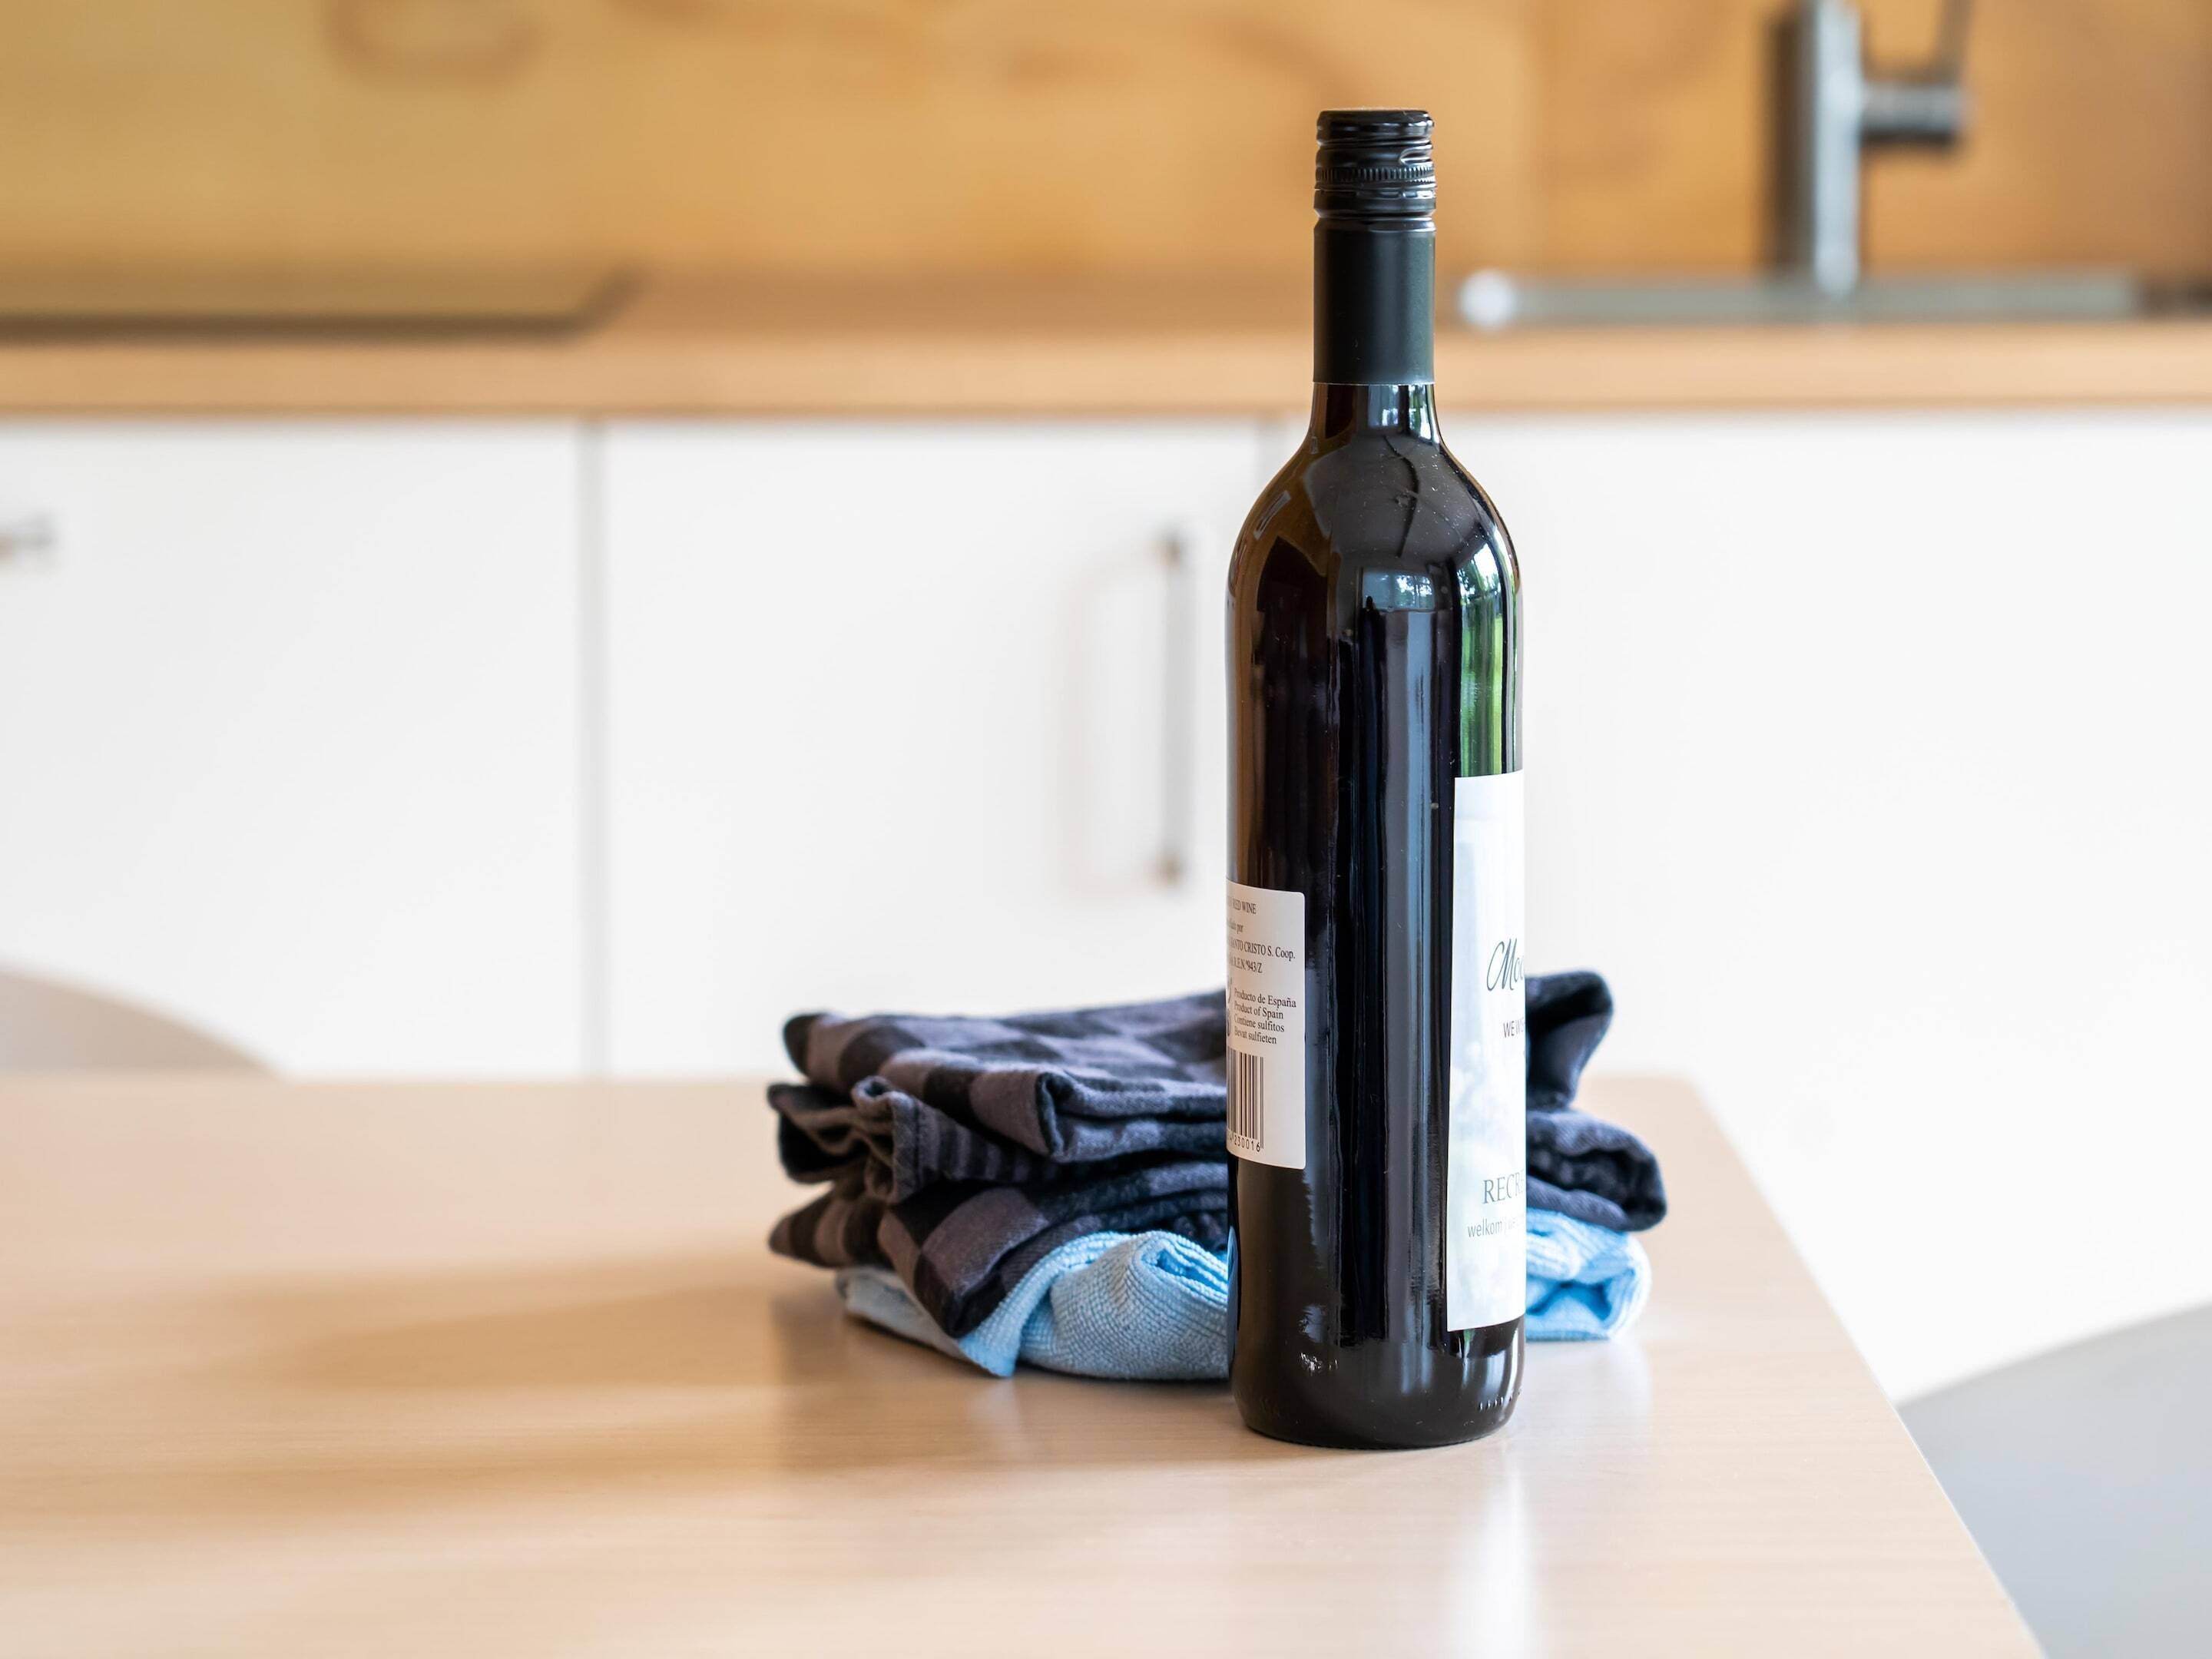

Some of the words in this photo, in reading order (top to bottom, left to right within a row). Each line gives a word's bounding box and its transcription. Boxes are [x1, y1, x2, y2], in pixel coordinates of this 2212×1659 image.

[1241, 901, 1257, 915] WINE
[1243, 941, 1267, 955] CRISTO
[1267, 945, 1273, 957] S.
[1275, 946, 1296, 962] Coop.
[1234, 988, 1256, 1002] Producto
[1257, 994, 1266, 1004] de
[1267, 995, 1296, 1008] España
[1234, 1001, 1252, 1015] Product
[1253, 1007, 1261, 1016] of
[1262, 1008, 1283, 1020] Spain
[1234, 1014, 1256, 1028] Contiene
[1257, 1020, 1285, 1033] sulfitos
[1502, 1020, 1515, 1038] WE
[1234, 1025, 1247, 1039] Bevat
[1248, 1031, 1277, 1045] sulfieten
[1467, 1217, 1502, 1238] welkom
